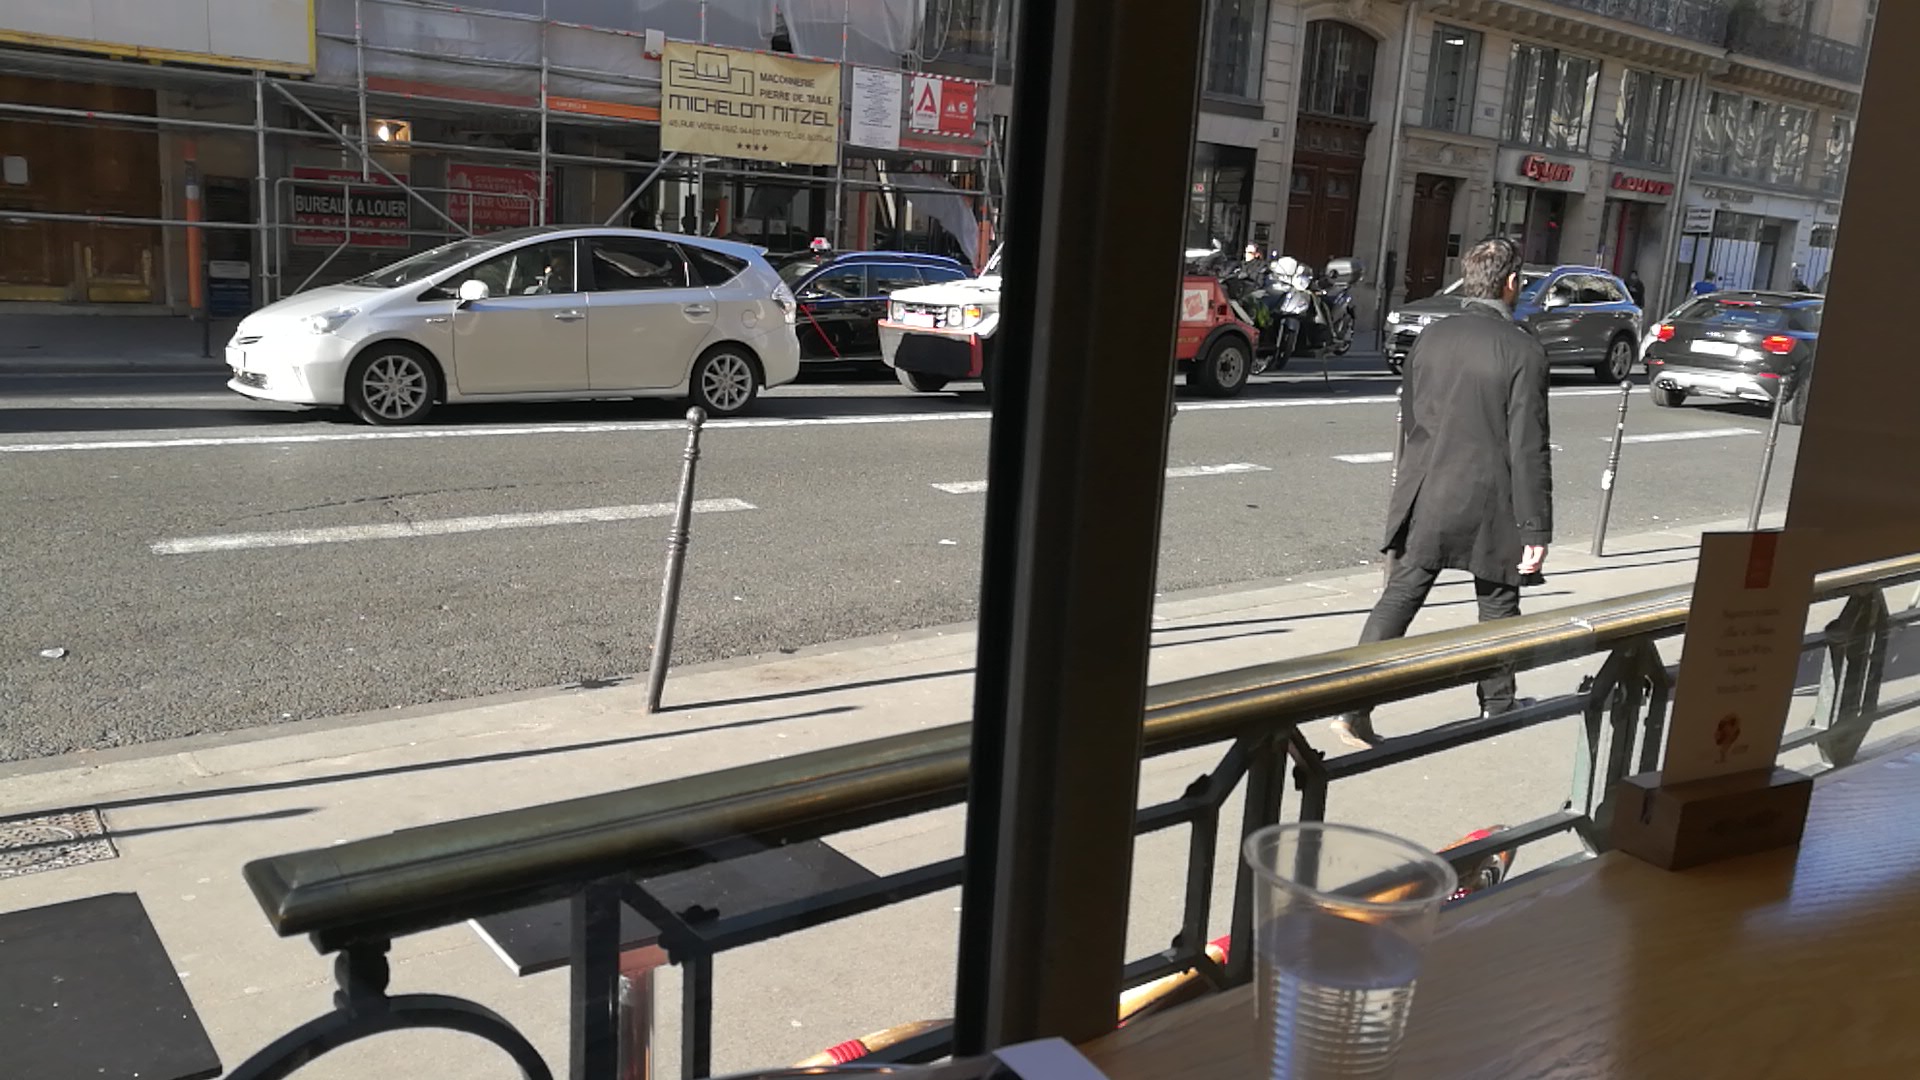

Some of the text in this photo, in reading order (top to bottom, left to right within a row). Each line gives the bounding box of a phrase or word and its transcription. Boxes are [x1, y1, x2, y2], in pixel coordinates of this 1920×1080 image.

[759, 88, 834, 106] PIERRE DE TAILLE
[669, 94, 834, 127] MICHELON NITZEL
[1523, 152, 1576, 183] Gym
[355, 199, 366, 215] A
[367, 199, 407, 217] LOUER
[460, 195, 494, 207] LUER
